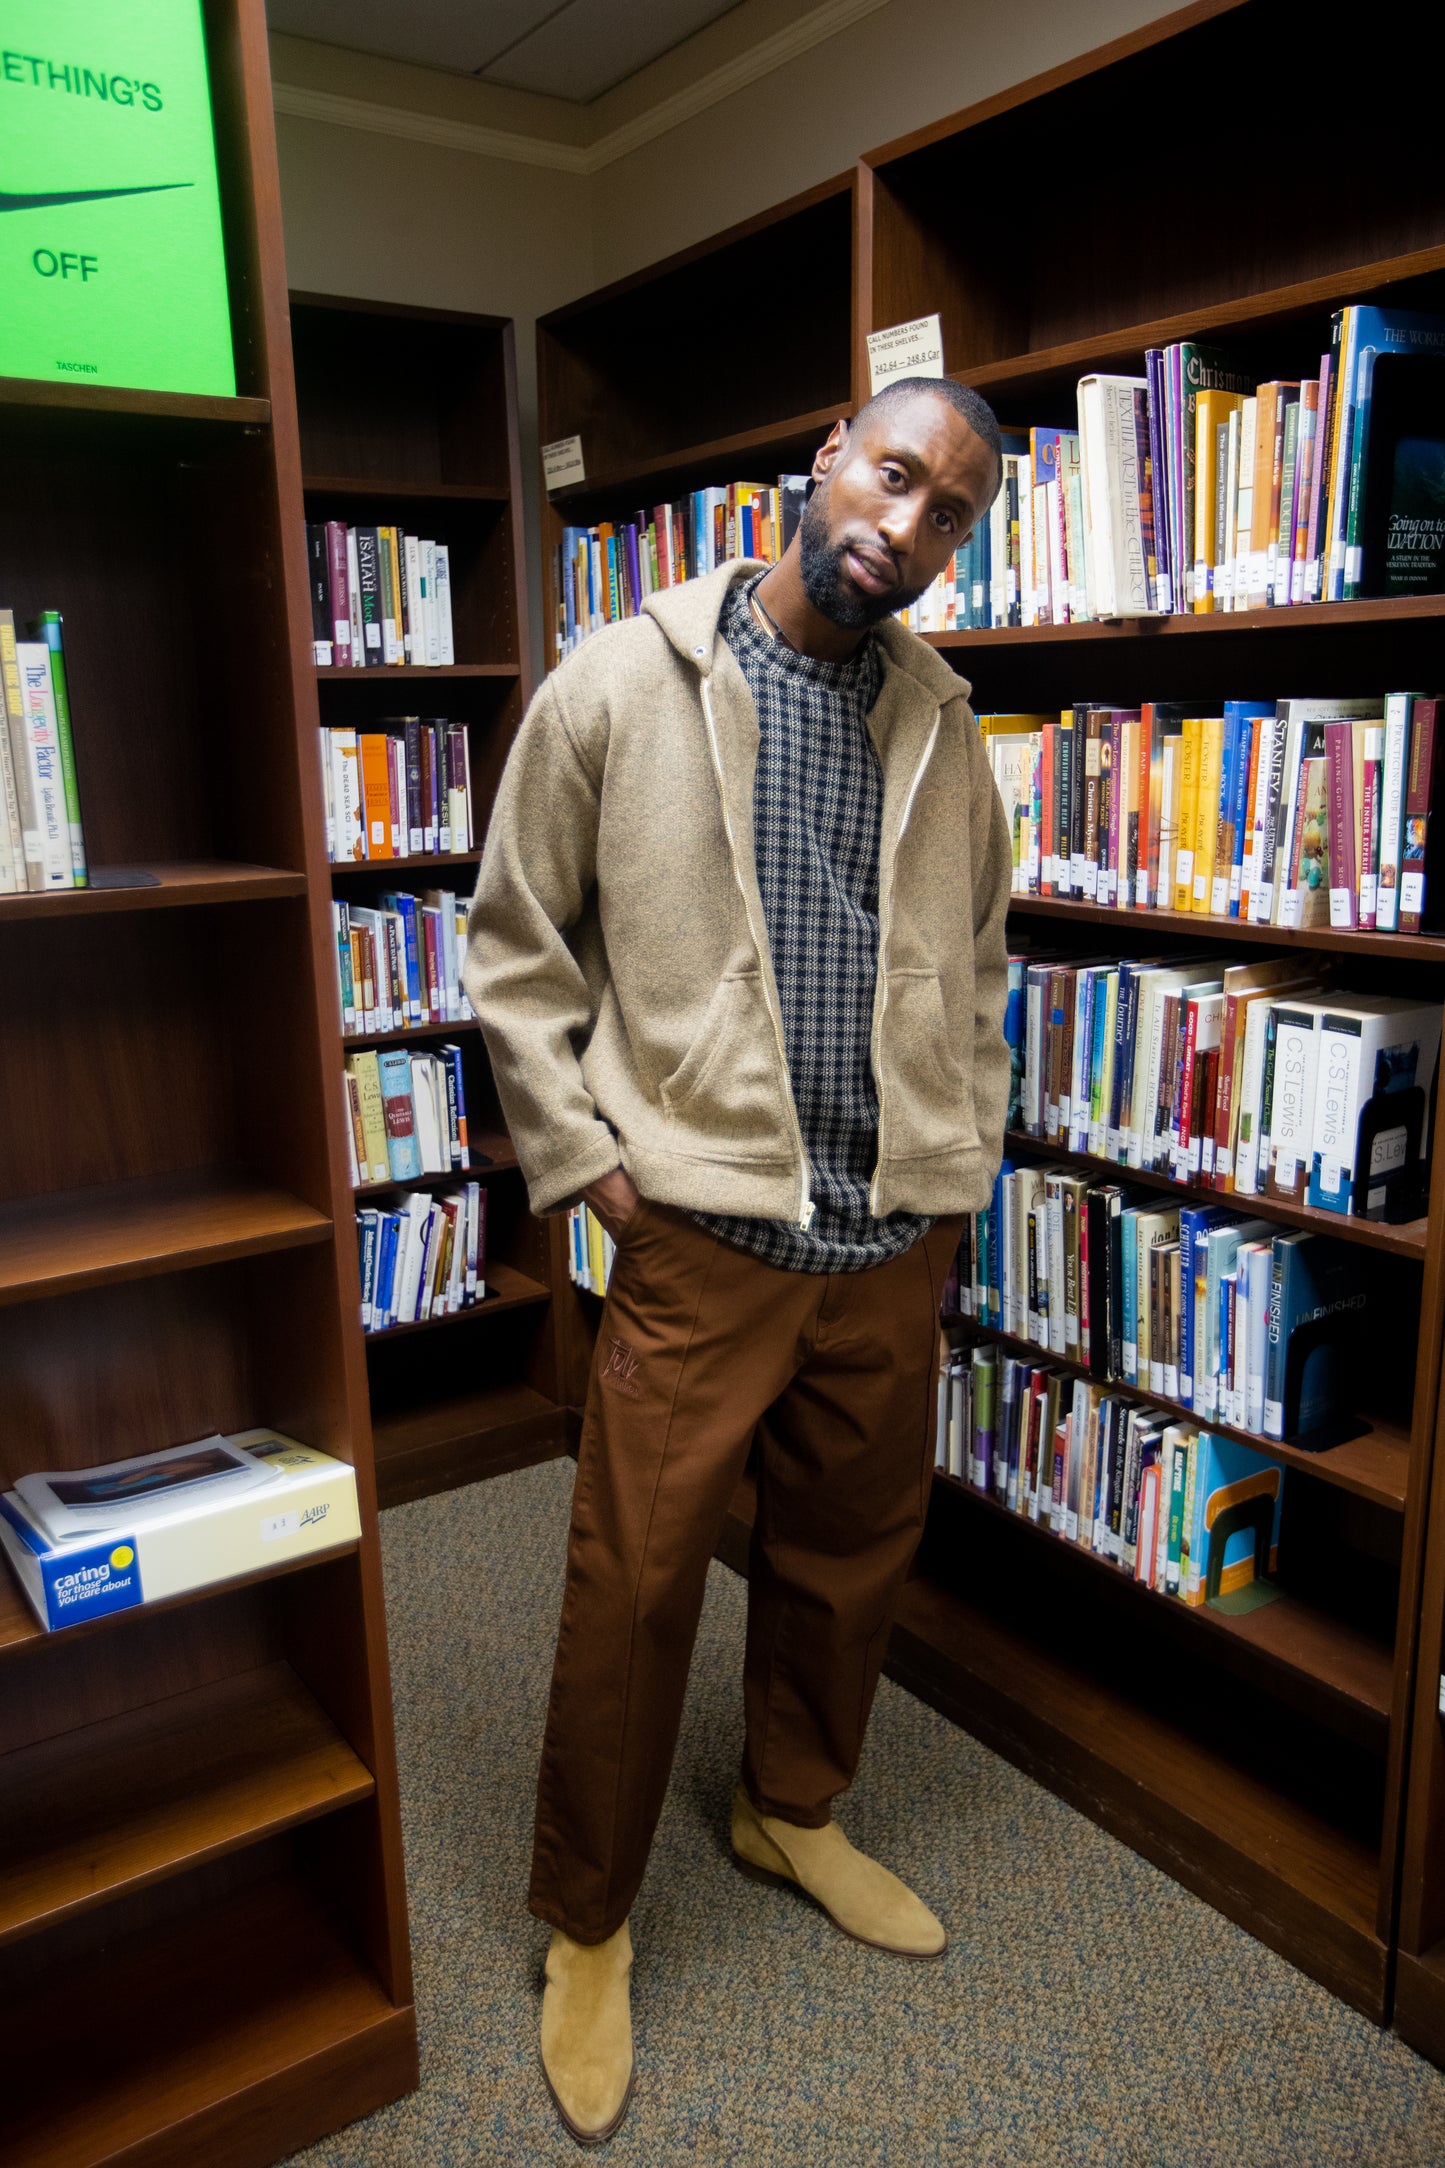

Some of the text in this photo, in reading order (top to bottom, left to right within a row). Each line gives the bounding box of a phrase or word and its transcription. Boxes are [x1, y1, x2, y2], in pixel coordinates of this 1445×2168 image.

[2, 51, 163, 112] ETHING'S
[33, 248, 98, 281] OFF
[868, 320, 928, 344] CALL NUMBERS FOUND
[878, 342, 894, 351] THESE
[1384, 328, 1406, 343] THE
[56, 361, 98, 374] TASCHEN
[928, 350, 940, 360] Car
[1282, 462, 1295, 489] LIFE
[1118, 388, 1145, 609] TEXTILE ART in the CHURCH
[1277, 496, 1292, 557] TOGETHE
[1388, 533, 1444, 550] LVATION
[1389, 514, 1445, 537] Going on to
[358, 536, 377, 623] ISAIAH Moty
[6, 664, 20, 686] ONE
[26, 664, 54, 780] The Longevity Factor
[1239, 761, 1245, 770] BY
[1268, 718, 1287, 792] STANLEY
[1061, 783, 1068, 792] OF
[1086, 780, 1095, 820] Christian
[1180, 740, 1192, 849] FOSTER PRAYER
[1196, 742, 1209, 850] FOSTER PRAYER
[1388, 724, 1402, 846] PRACTICING OUR FAITH
[1362, 806, 1371, 834] INNER
[1264, 826, 1275, 868] ULTIMATE
[1360, 836, 1369, 875] EXPERIEN
[1115, 1002, 1126, 1044] Journey
[1136, 1014, 1144, 1028] TO
[1150, 1036, 1159, 1064] Starts
[1184, 1044, 1192, 1072] GREAT
[364, 1092, 381, 1101] Lewis
[448, 1075, 458, 1140] Christian Reflections
[1146, 1082, 1155, 1115] HOME
[1052, 1210, 1060, 1232] JOEL
[362, 1230, 374, 1302] John and Charles Wesley
[1124, 1262, 1130, 1272] TO
[1066, 1254, 1075, 1316] YOUR Best Lif
[1268, 1260, 1283, 1343] UNFINISHED
[1116, 1407, 1126, 1444] Stewards
[1112, 1468, 1122, 1504] Kingdom
[1172, 1450, 1182, 1491] HALFTIME
[302, 1504, 330, 1520] AARP
[54, 1563, 111, 1590] caring
[58, 1580, 102, 1600] for those
[58, 1576, 132, 1608] you care about
